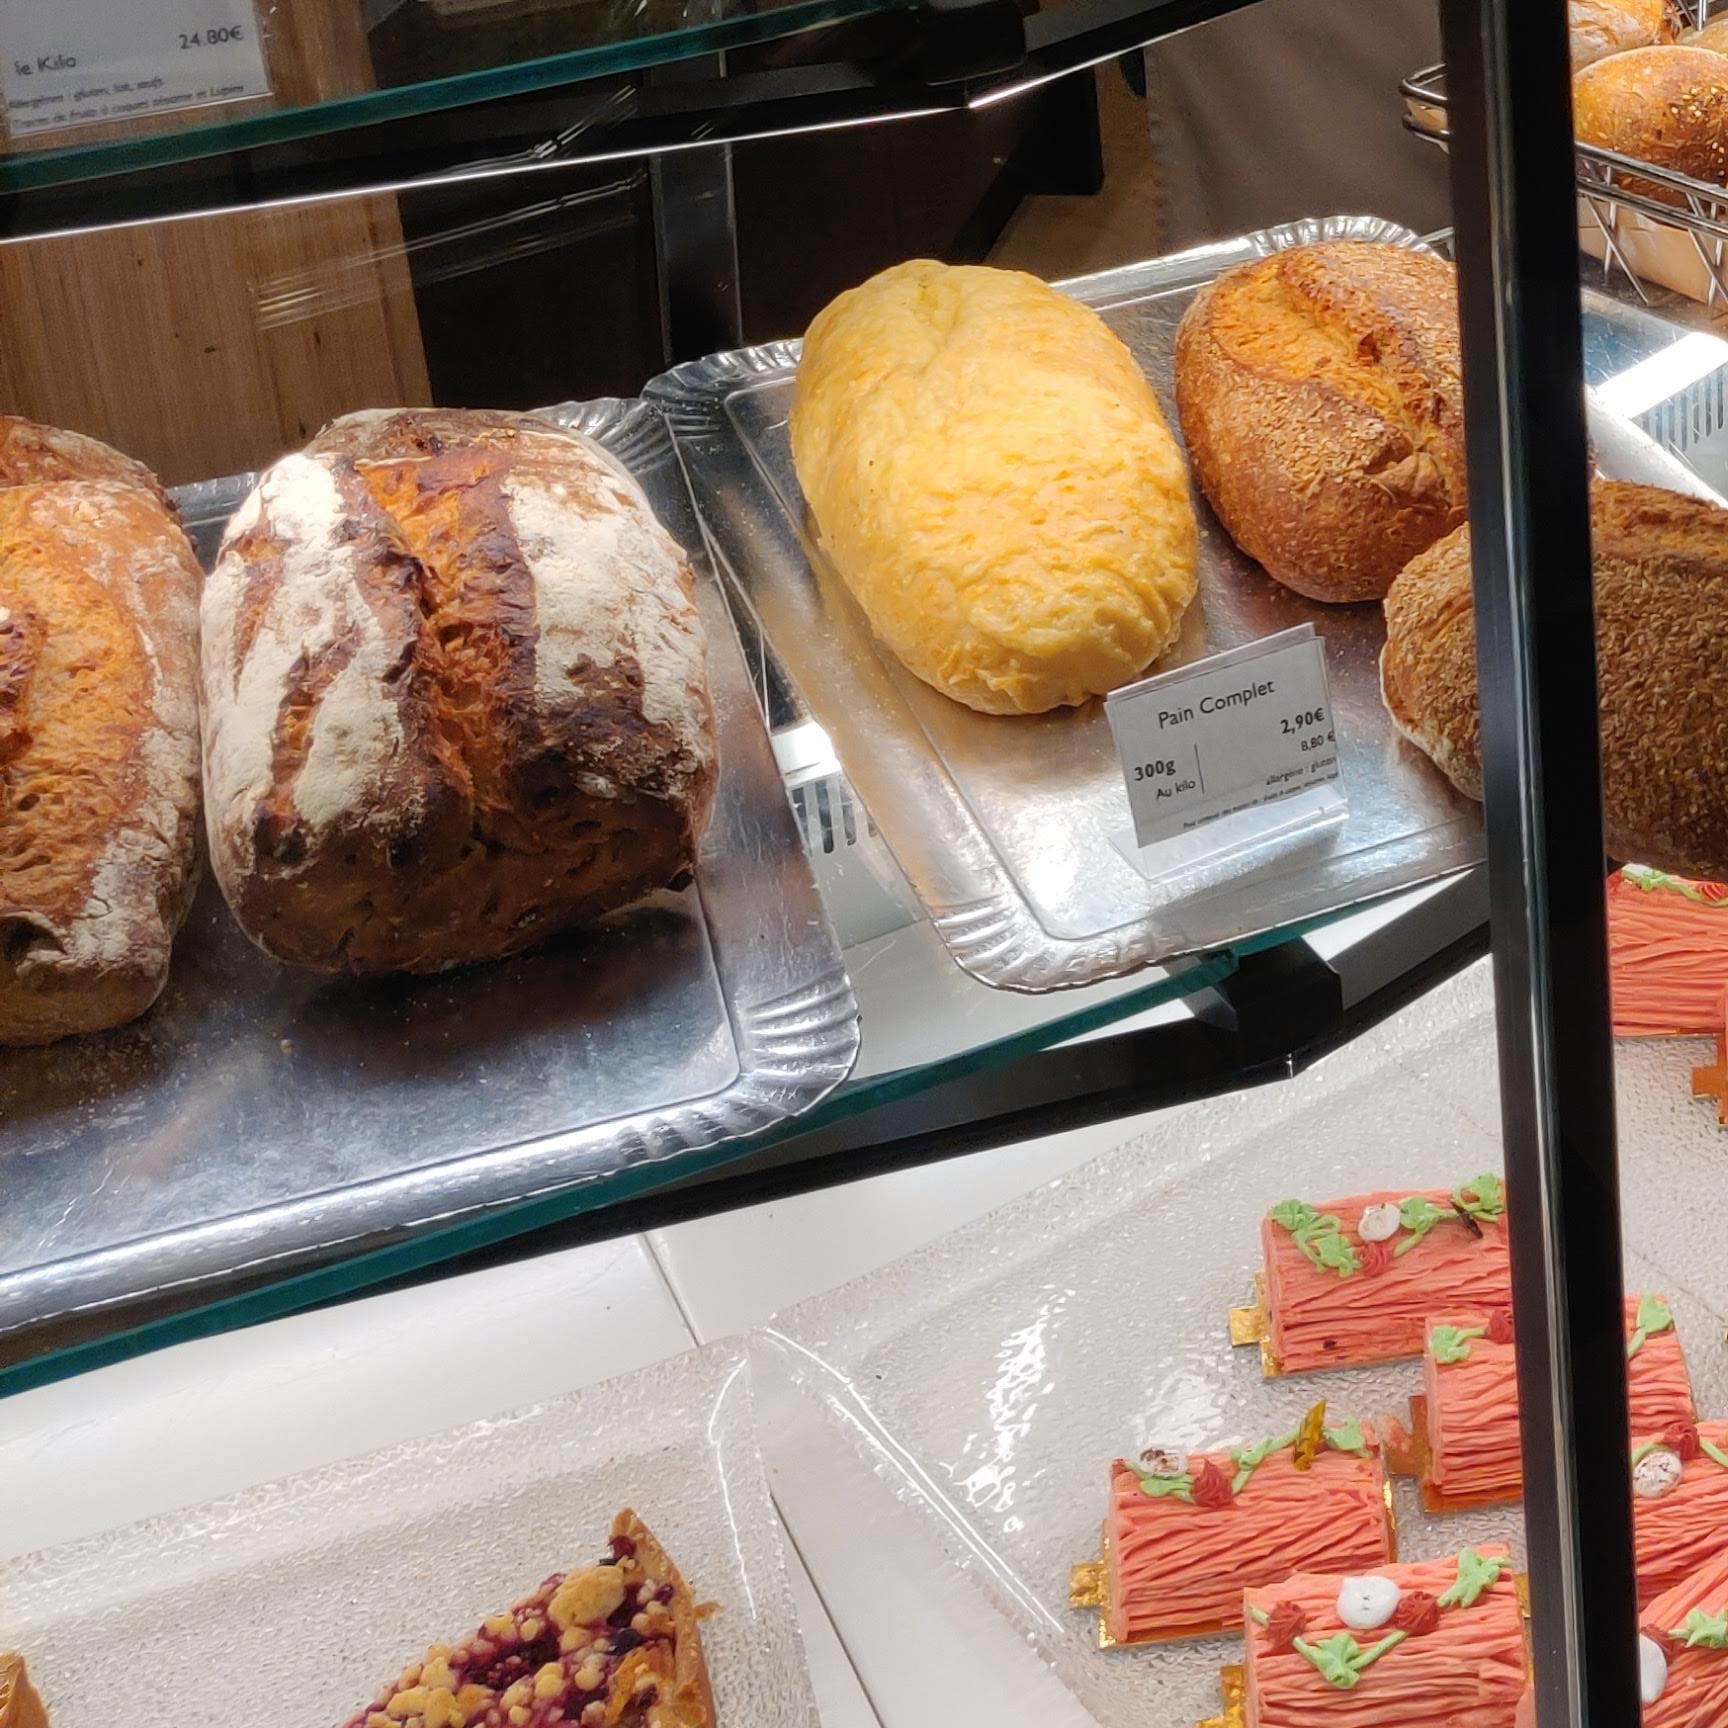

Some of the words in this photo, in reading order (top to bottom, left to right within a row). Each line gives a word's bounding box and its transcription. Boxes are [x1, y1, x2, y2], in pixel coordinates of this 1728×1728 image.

[37, 54, 77, 71] Kilo
[1158, 706, 1194, 730] Pain
[1199, 680, 1276, 714] Complet
[1280, 707, 1326, 735] 2,90€
[1133, 759, 1177, 782] 300g
[1155, 786, 1173, 800] Au
[1175, 779, 1197, 796] kilo
